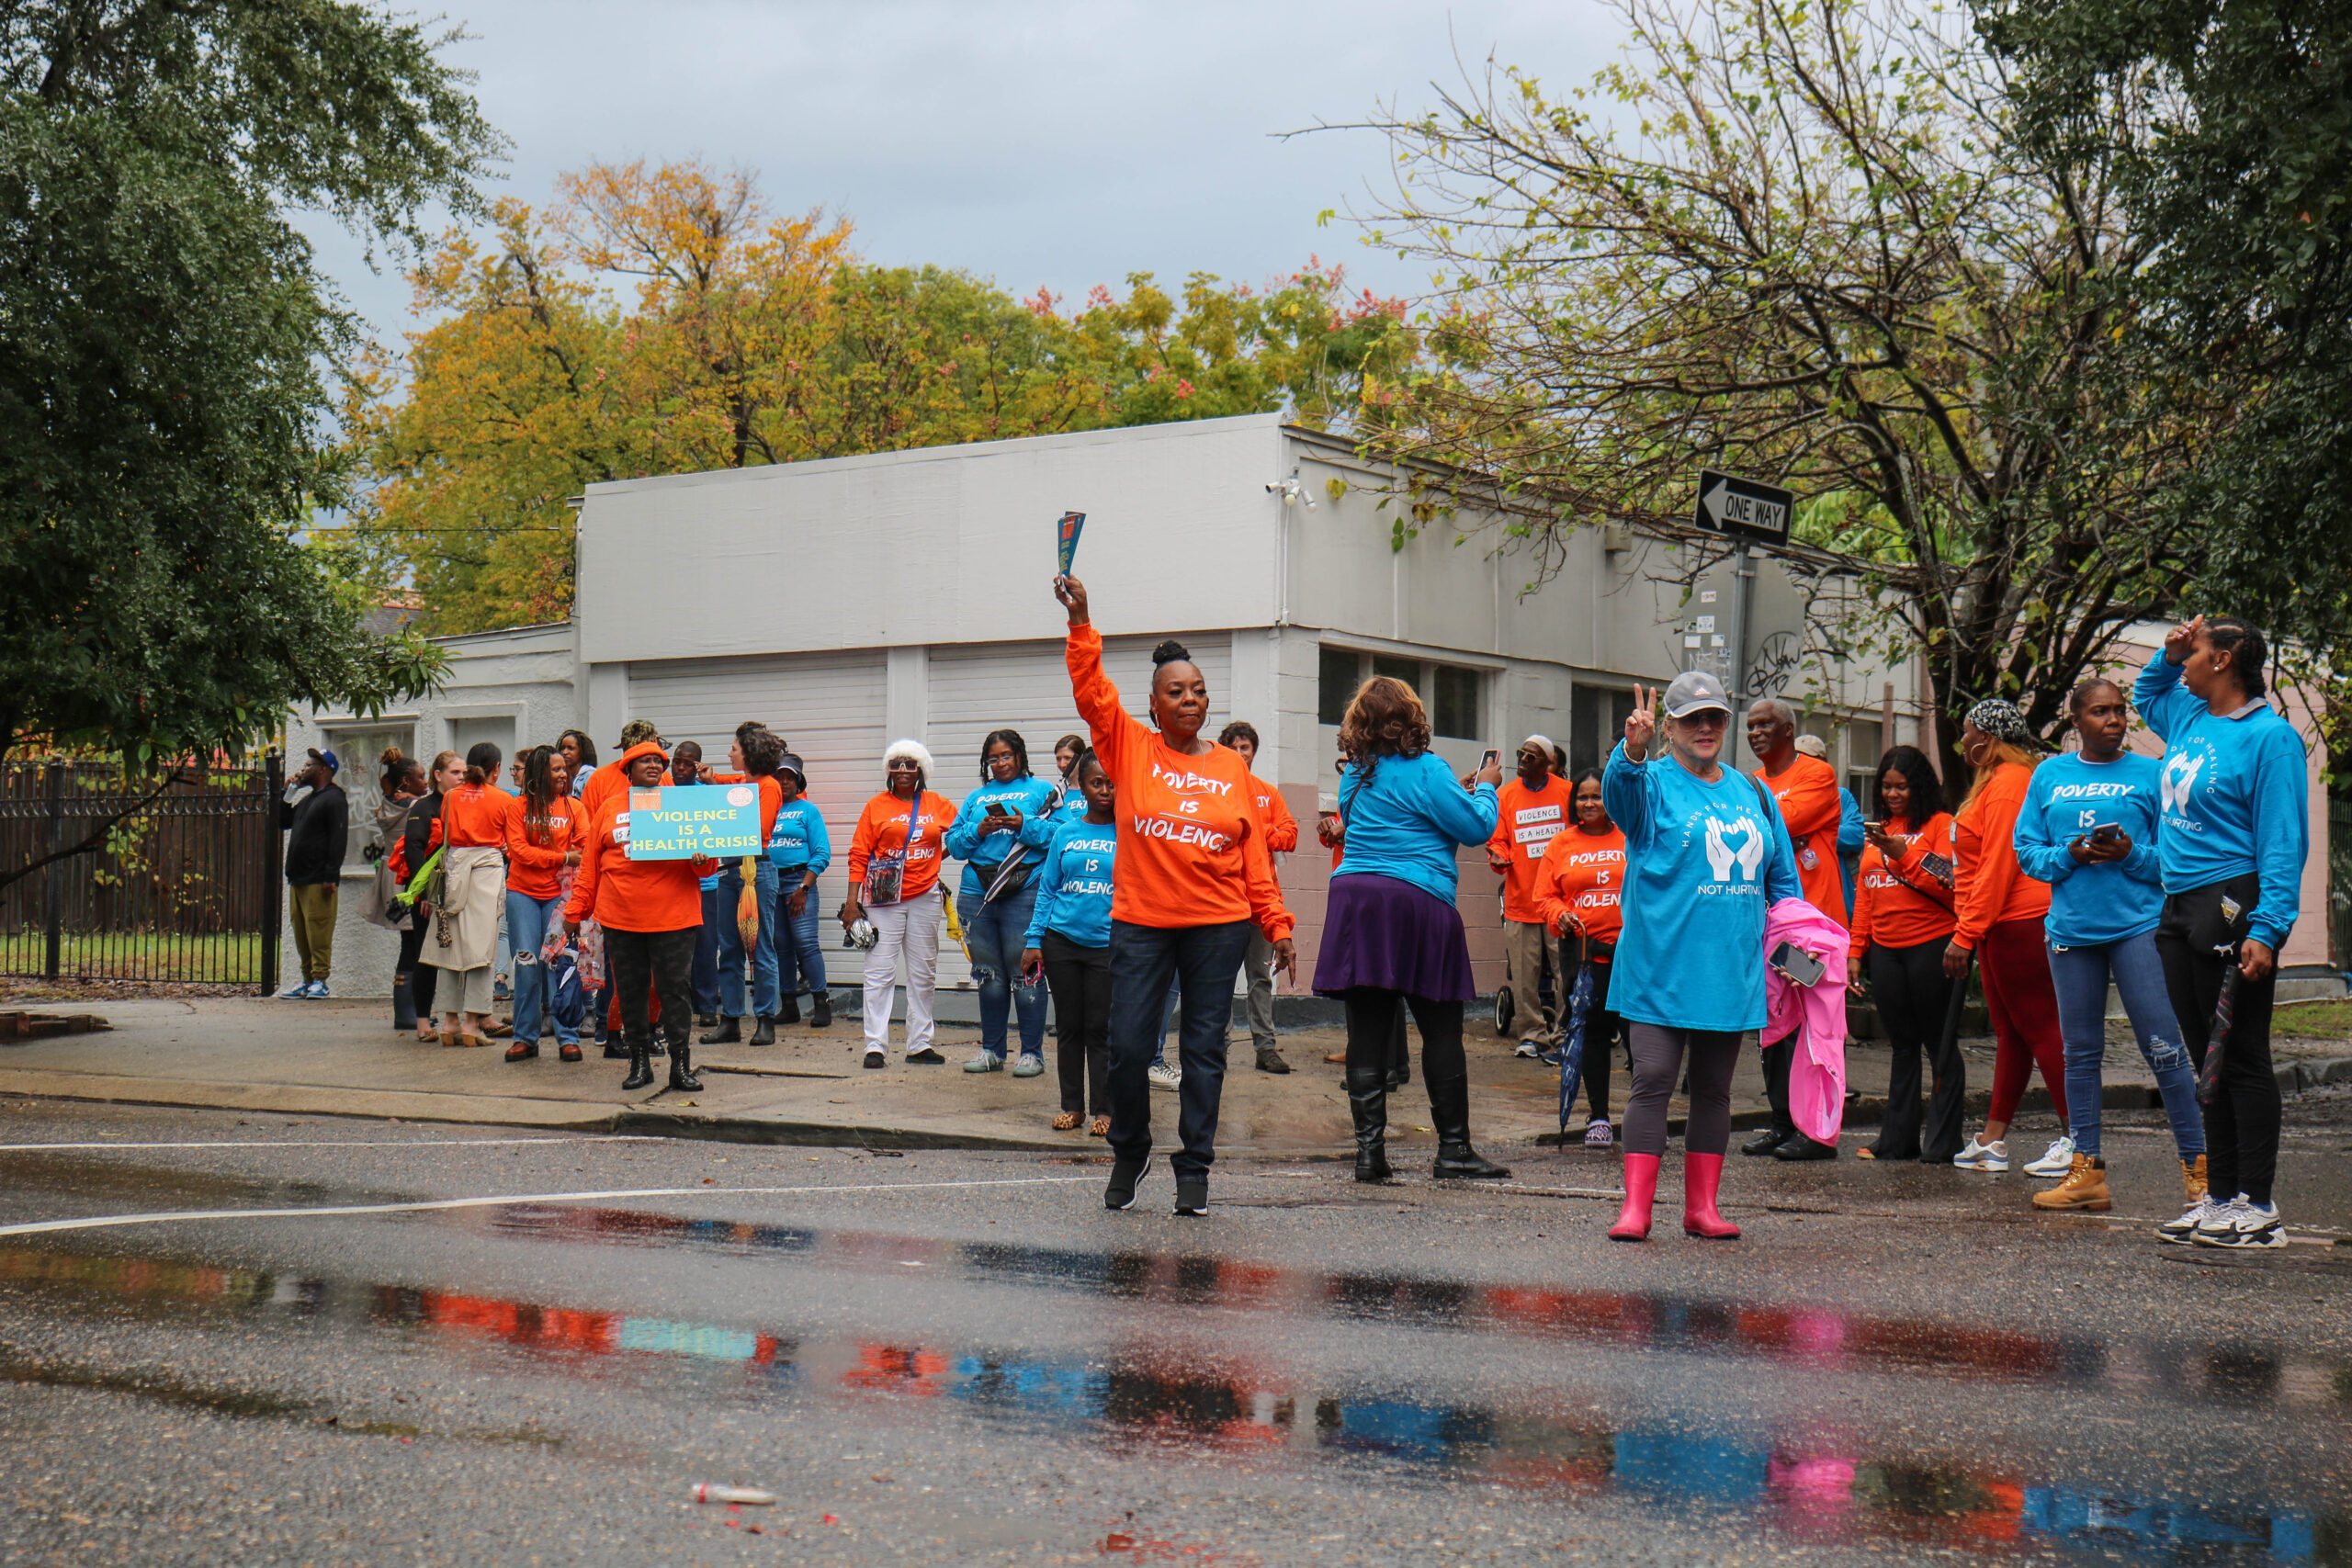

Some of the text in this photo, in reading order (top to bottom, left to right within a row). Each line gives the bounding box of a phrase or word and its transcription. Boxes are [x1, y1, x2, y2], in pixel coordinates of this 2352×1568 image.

[1725, 494, 1781, 527] ONE WAY
[2206, 742, 2218, 794] HEALING
[976, 792, 1029, 805] POVERTY
[2052, 783, 2135, 802] POVERTY
[1179, 800, 1200, 813] IS
[651, 808, 738, 822] VIOLENCE
[1518, 808, 1558, 820] VIOLENCE
[2078, 809, 2096, 828] IS
[678, 824, 712, 836] IS A
[1518, 831, 1525, 840] IS
[1527, 829, 1533, 838] A
[1682, 811, 1702, 847] HANDS
[632, 838, 698, 851] HEALTH
[703, 835, 759, 849] CRISIS
[1065, 840, 1117, 852] POVERT
[1086, 859, 1099, 872] IS
[1597, 871, 1610, 885] IS
[1062, 881, 1114, 896] VIOLENC
[1698, 885, 1723, 895] NOT
[1573, 893, 1621, 908] VIOLEN
